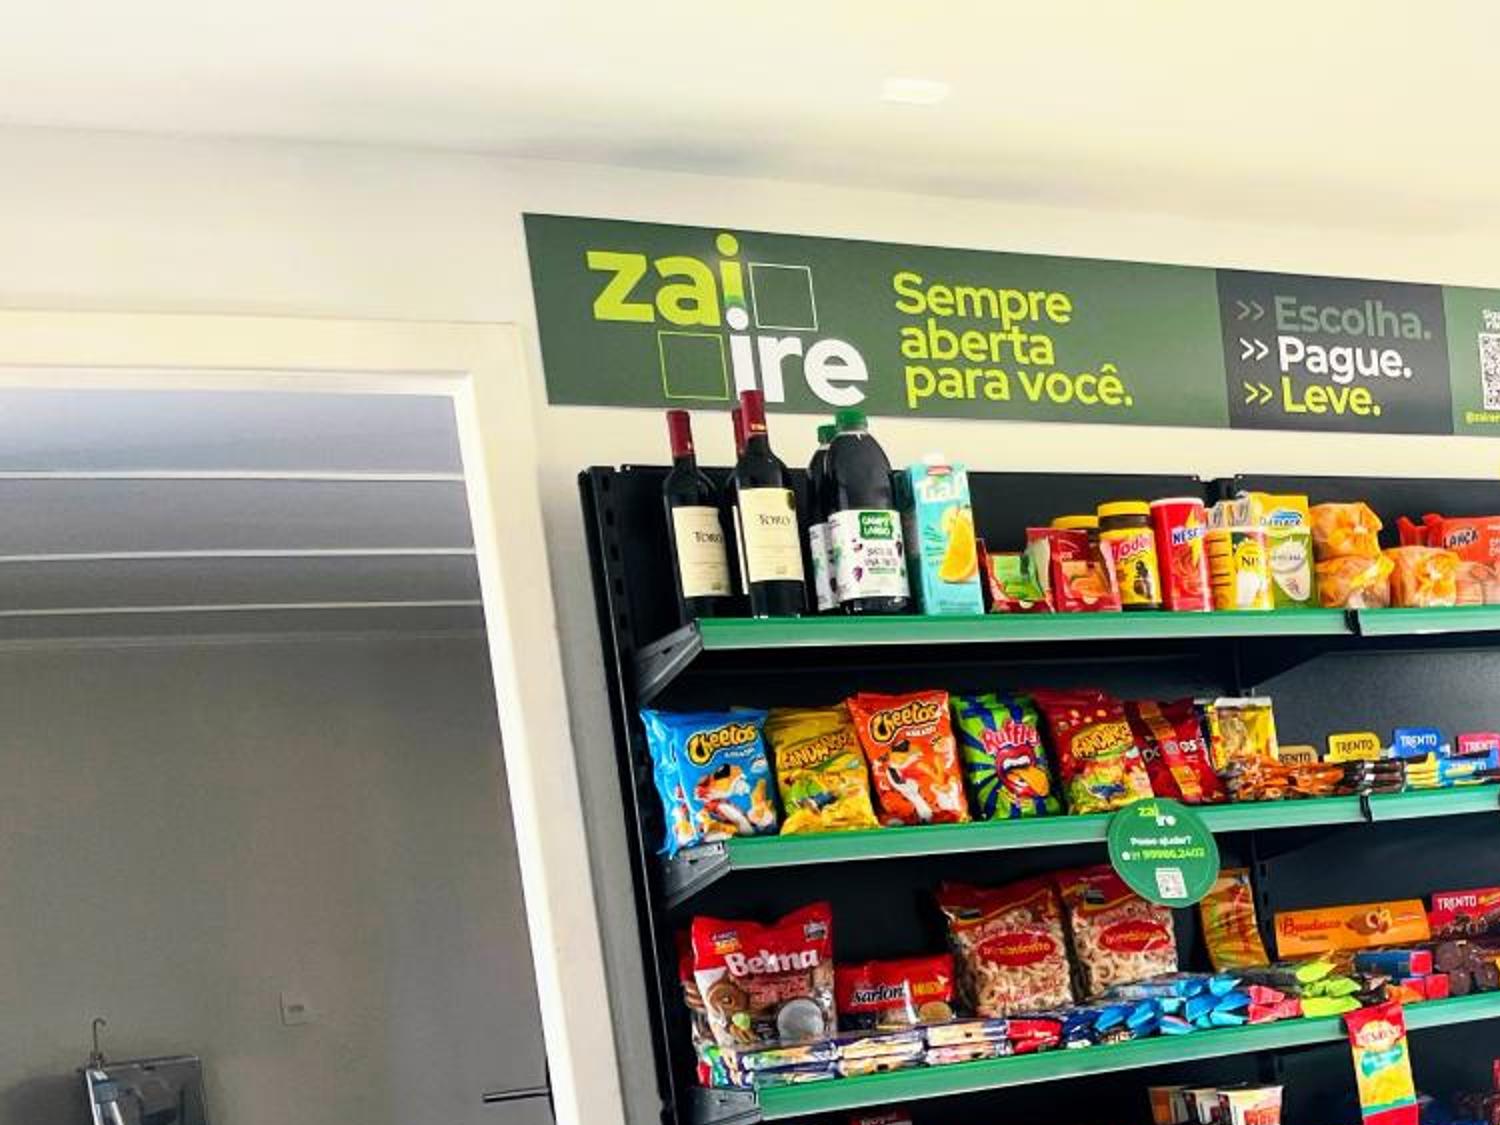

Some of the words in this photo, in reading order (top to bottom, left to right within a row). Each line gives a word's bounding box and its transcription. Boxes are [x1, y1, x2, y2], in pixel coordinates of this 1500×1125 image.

[587, 234, 746, 327] zai
[894, 272, 1071, 330] Sempre
[1275, 296, 1432, 340] Escolha.
[726, 307, 868, 406] ire
[902, 318, 1055, 366] aberta
[1278, 336, 1413, 381] Pague.
[904, 366, 1010, 408] para
[1019, 363, 1133, 407] você.
[1282, 377, 1382, 416] Leve.
[869, 701, 942, 743] Cheetos
[1400, 733, 1437, 748] TRENTO
[686, 723, 757, 766] Cheetos
[1335, 738, 1374, 755] TRENTO
[1437, 894, 1477, 911] TRENTO
